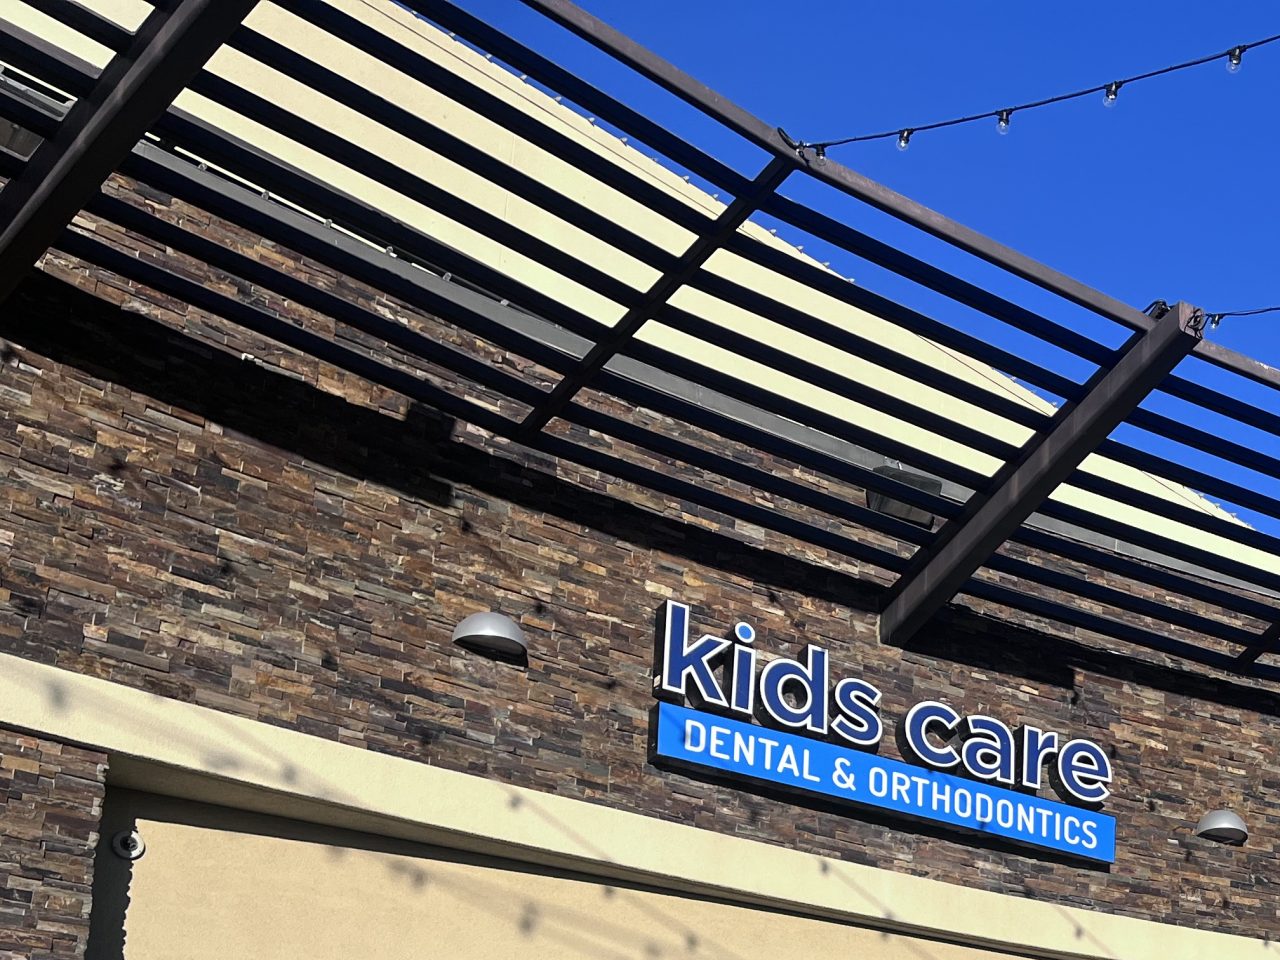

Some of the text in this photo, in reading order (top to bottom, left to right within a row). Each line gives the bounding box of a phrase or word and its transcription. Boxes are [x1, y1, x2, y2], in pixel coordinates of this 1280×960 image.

[659, 599, 1113, 802] kids care
[683, 718, 1098, 850] DENTAL & ORTHODONTICS
